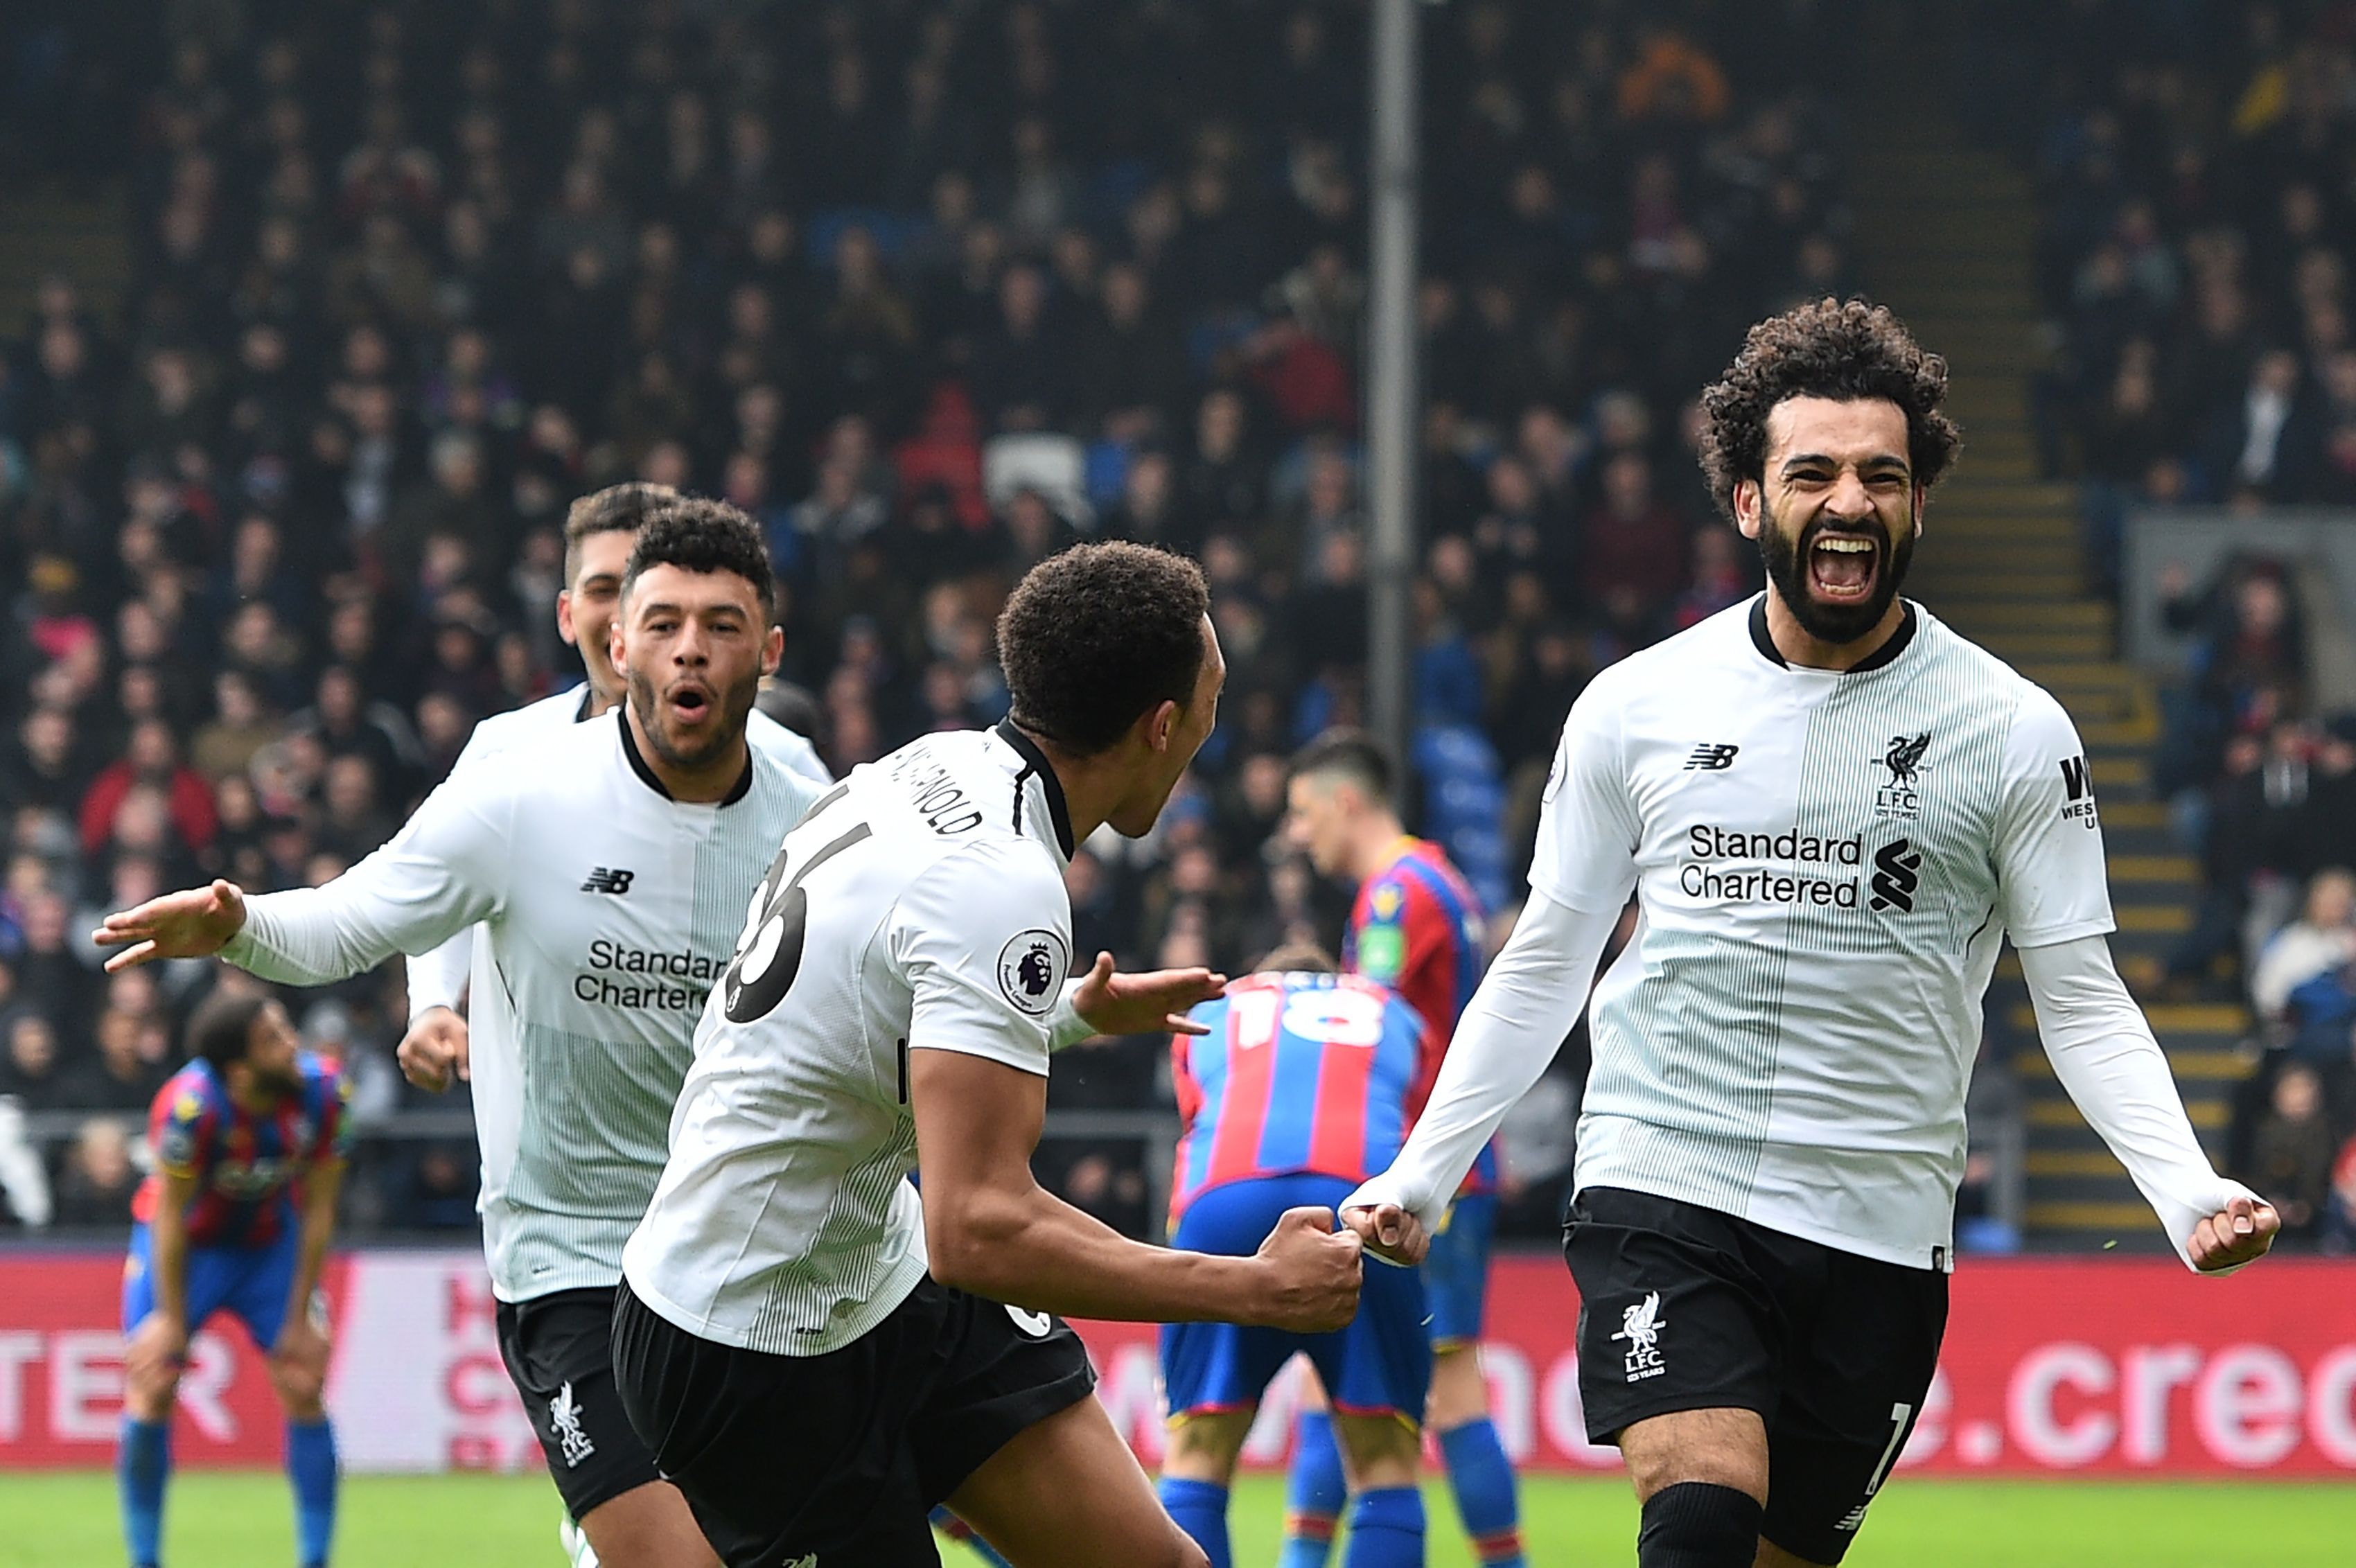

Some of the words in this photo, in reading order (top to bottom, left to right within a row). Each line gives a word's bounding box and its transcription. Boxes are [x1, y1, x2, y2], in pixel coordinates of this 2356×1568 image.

[1876, 791, 1918, 809] LFC
[1689, 824, 1862, 865] Standard
[1681, 865, 1858, 908] Chartered
[588, 940, 728, 981] Standar
[1229, 987, 1383, 1049] 18
[1625, 1350, 1666, 1373] LFC
